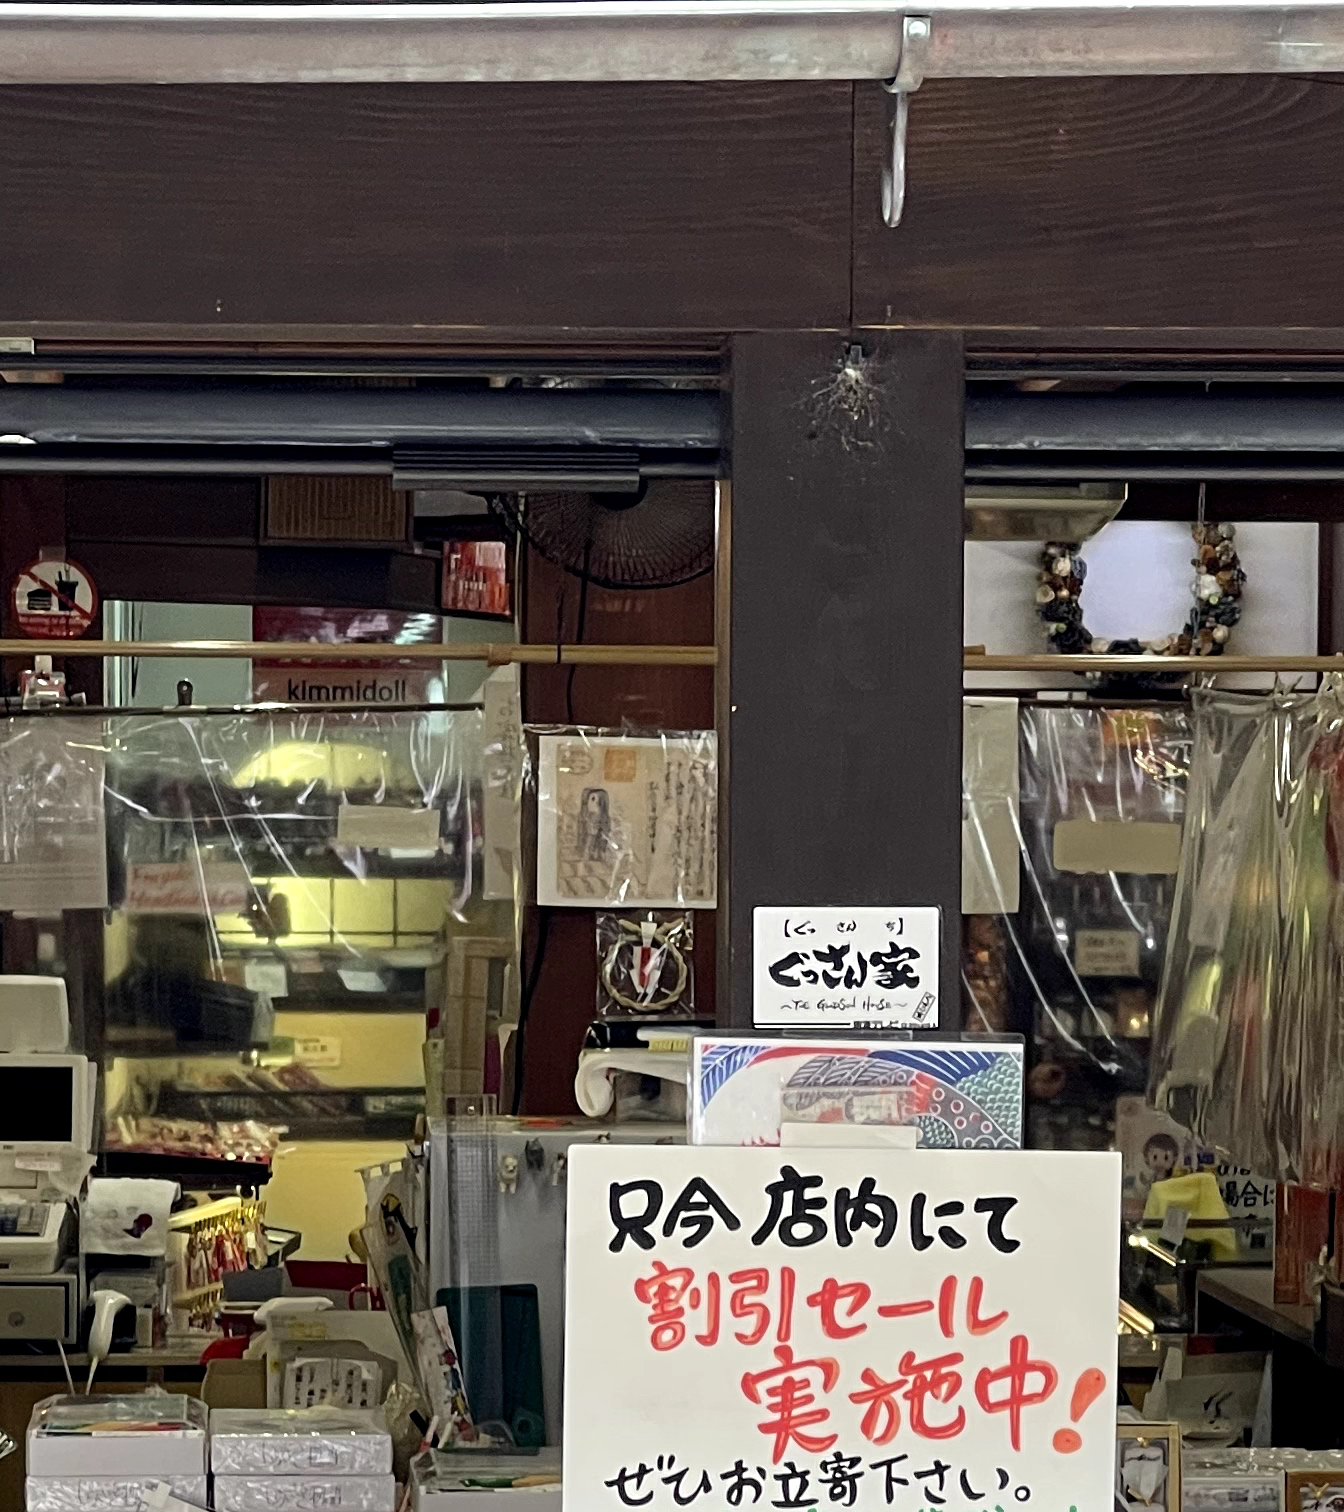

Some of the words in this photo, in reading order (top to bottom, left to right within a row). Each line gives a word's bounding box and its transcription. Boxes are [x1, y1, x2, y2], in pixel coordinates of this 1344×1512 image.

[287, 679, 406, 702] kimmidoll
[769, 941, 921, 990] ぐっさん家
[632, 1260, 1010, 1352] 割引セール
[603, 1452, 1033, 1509] ぜひお立寄下さい。
